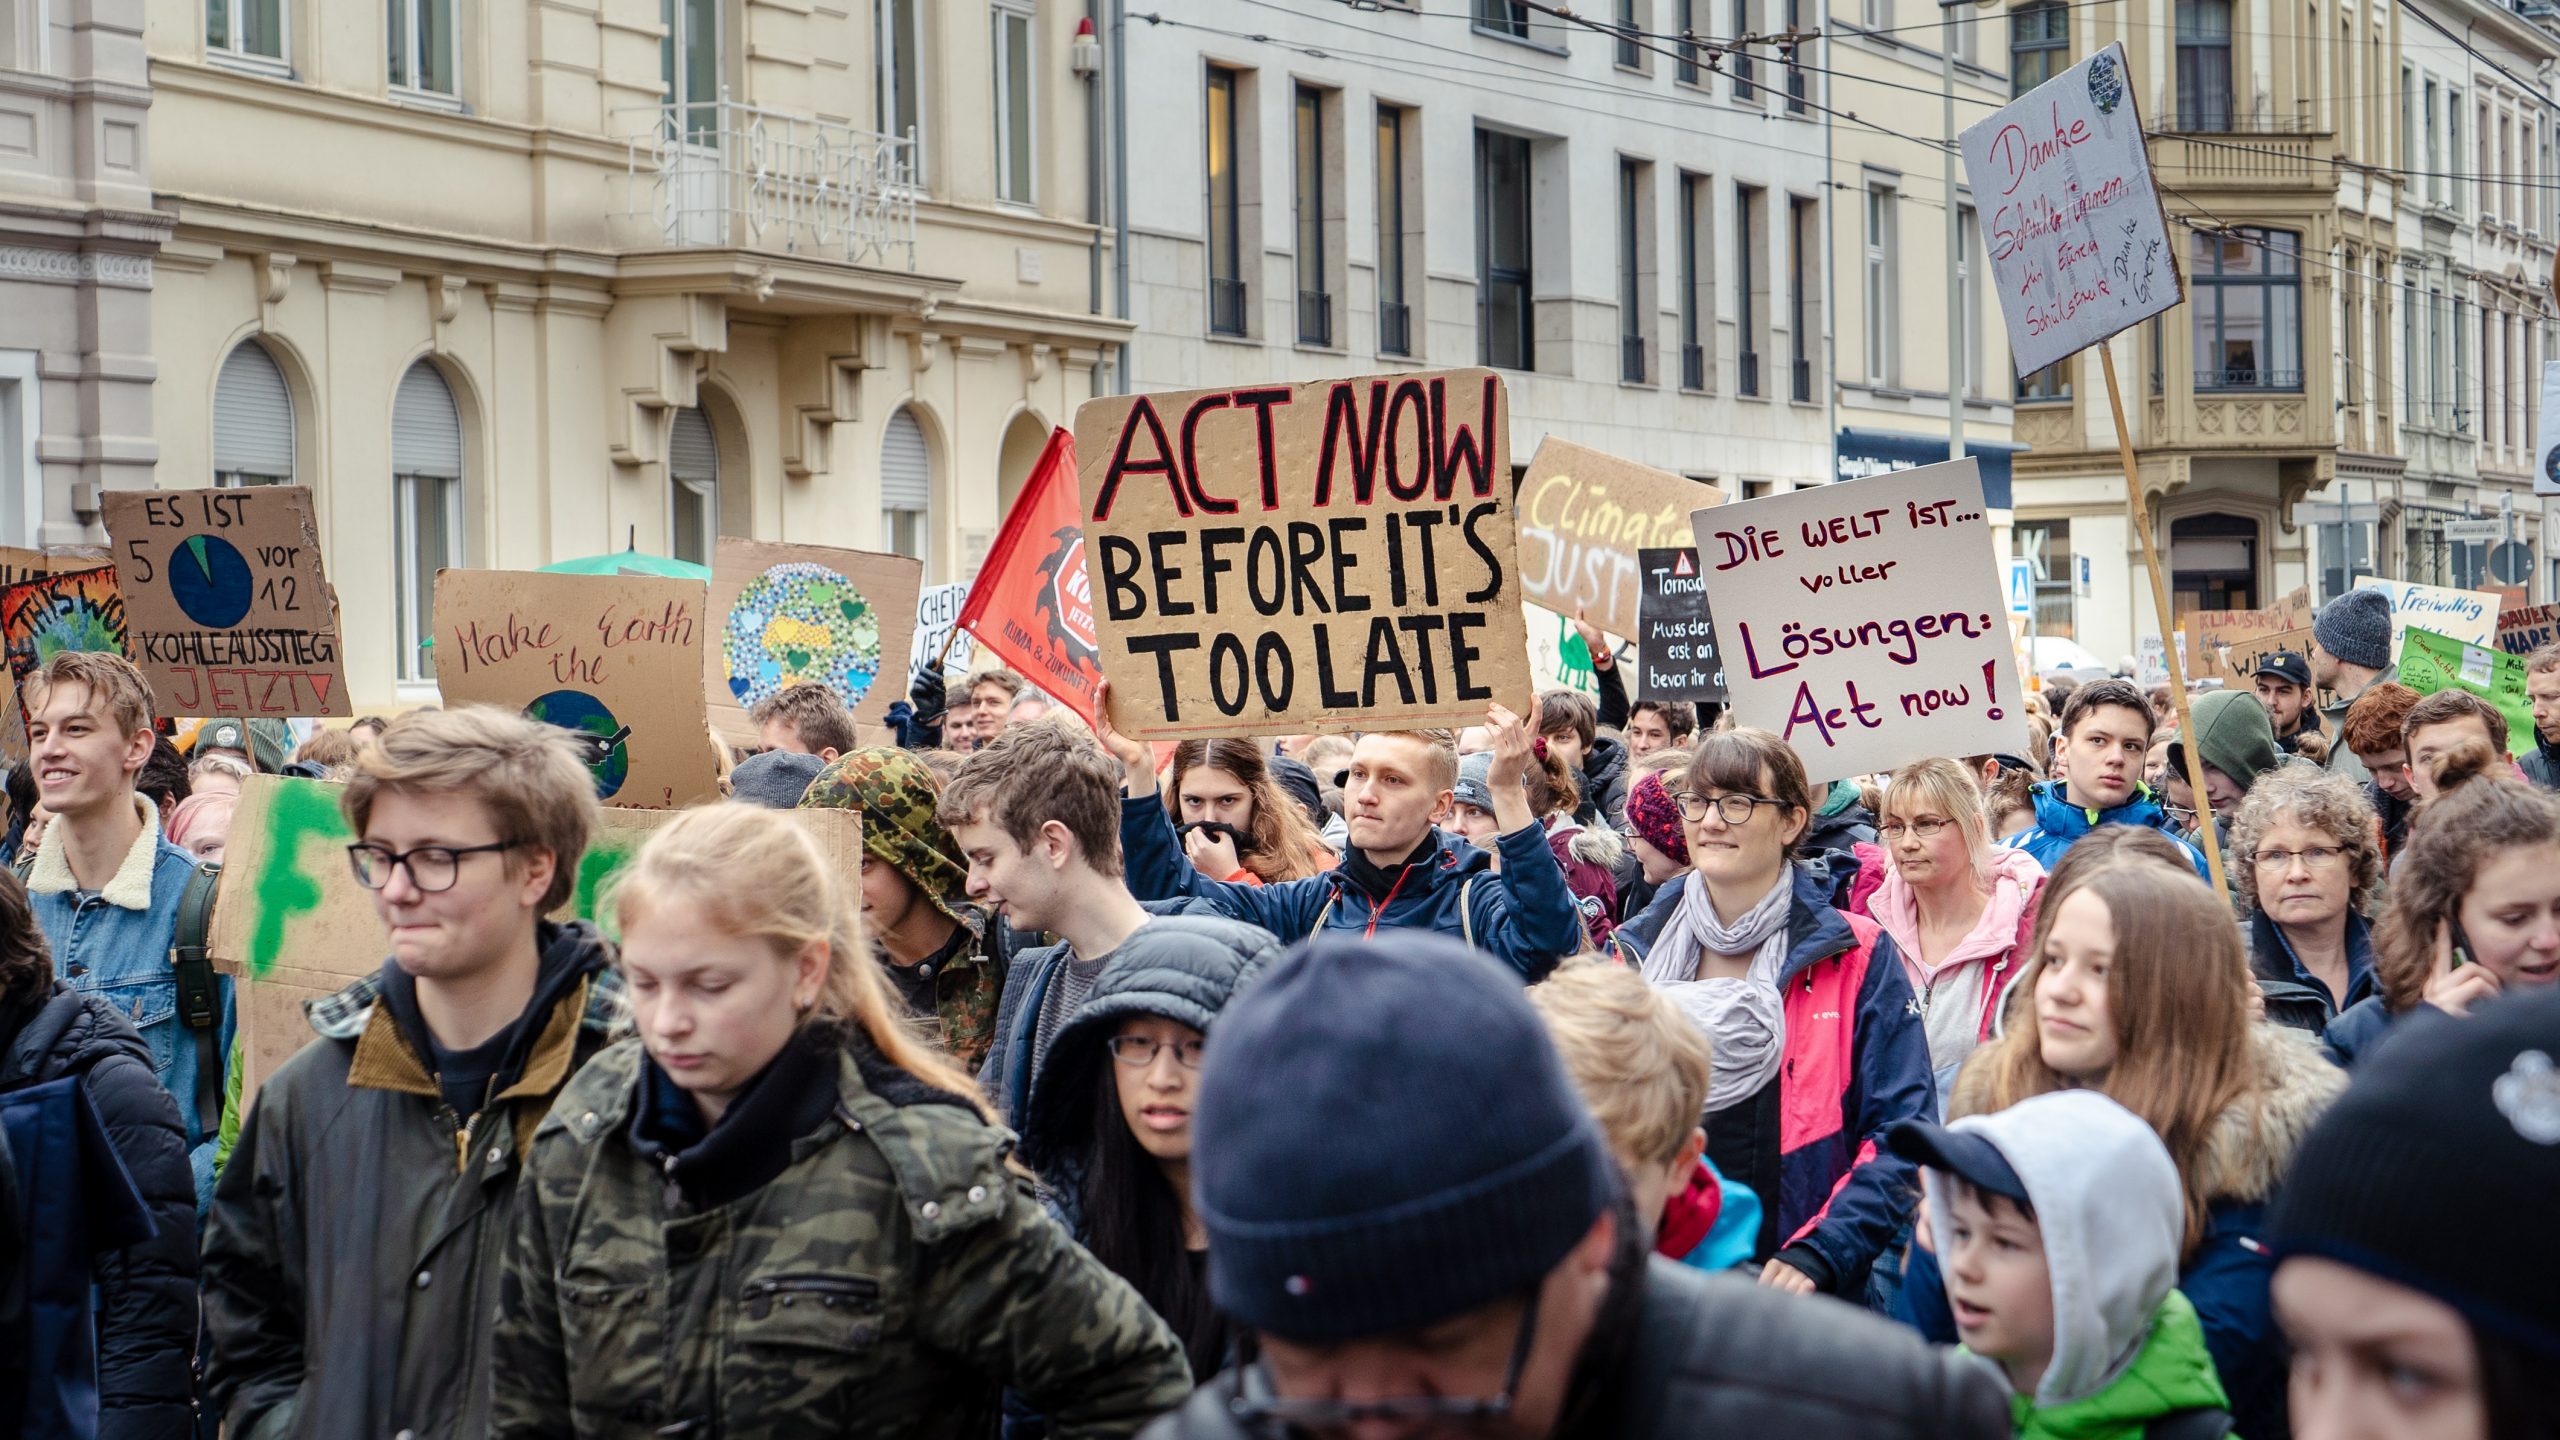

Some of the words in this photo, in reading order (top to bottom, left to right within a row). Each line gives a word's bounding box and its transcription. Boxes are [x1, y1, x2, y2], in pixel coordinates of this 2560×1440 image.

[1990, 101, 2091, 195] Danke
[1092, 386, 1293, 522] ACT
[1313, 375, 1498, 507] NOW
[145, 496, 184, 527] ES
[202, 494, 252, 527] IST
[1801, 508, 1890, 548] WELT
[128, 540, 153, 583] 5
[256, 544, 300, 569] vor
[1099, 517, 1372, 622] BEFORE
[1385, 499, 1504, 607] IT'S
[1652, 568, 1706, 596] Tornad
[8, 580, 74, 638] THIS
[259, 575, 300, 612] 12
[2401, 585, 2483, 621] Freiwillig
[142, 630, 334, 664] KOHLEAUSSTIEG
[454, 612, 562, 674] Make
[598, 600, 693, 650] Earth
[1652, 621, 1685, 640] Muss
[1689, 618, 1709, 637] der
[1668, 641, 1690, 660] erst
[1697, 642, 1713, 660] an
[1739, 611, 1992, 680] Lösungen:
[549, 650, 609, 684] the
[1002, 618, 1032, 653] KLIMA
[1033, 646, 1043, 663] &
[1044, 652, 1090, 696] ZUKUNFT
[1126, 631, 1294, 723] TOO
[1313, 612, 1493, 709] LATE
[170, 667, 332, 714] JETZT!
[1650, 669, 1688, 689] bevor
[1691, 669, 1707, 687] ihr
[1713, 669, 1728, 688] et
[1783, 680, 1882, 747] Act
